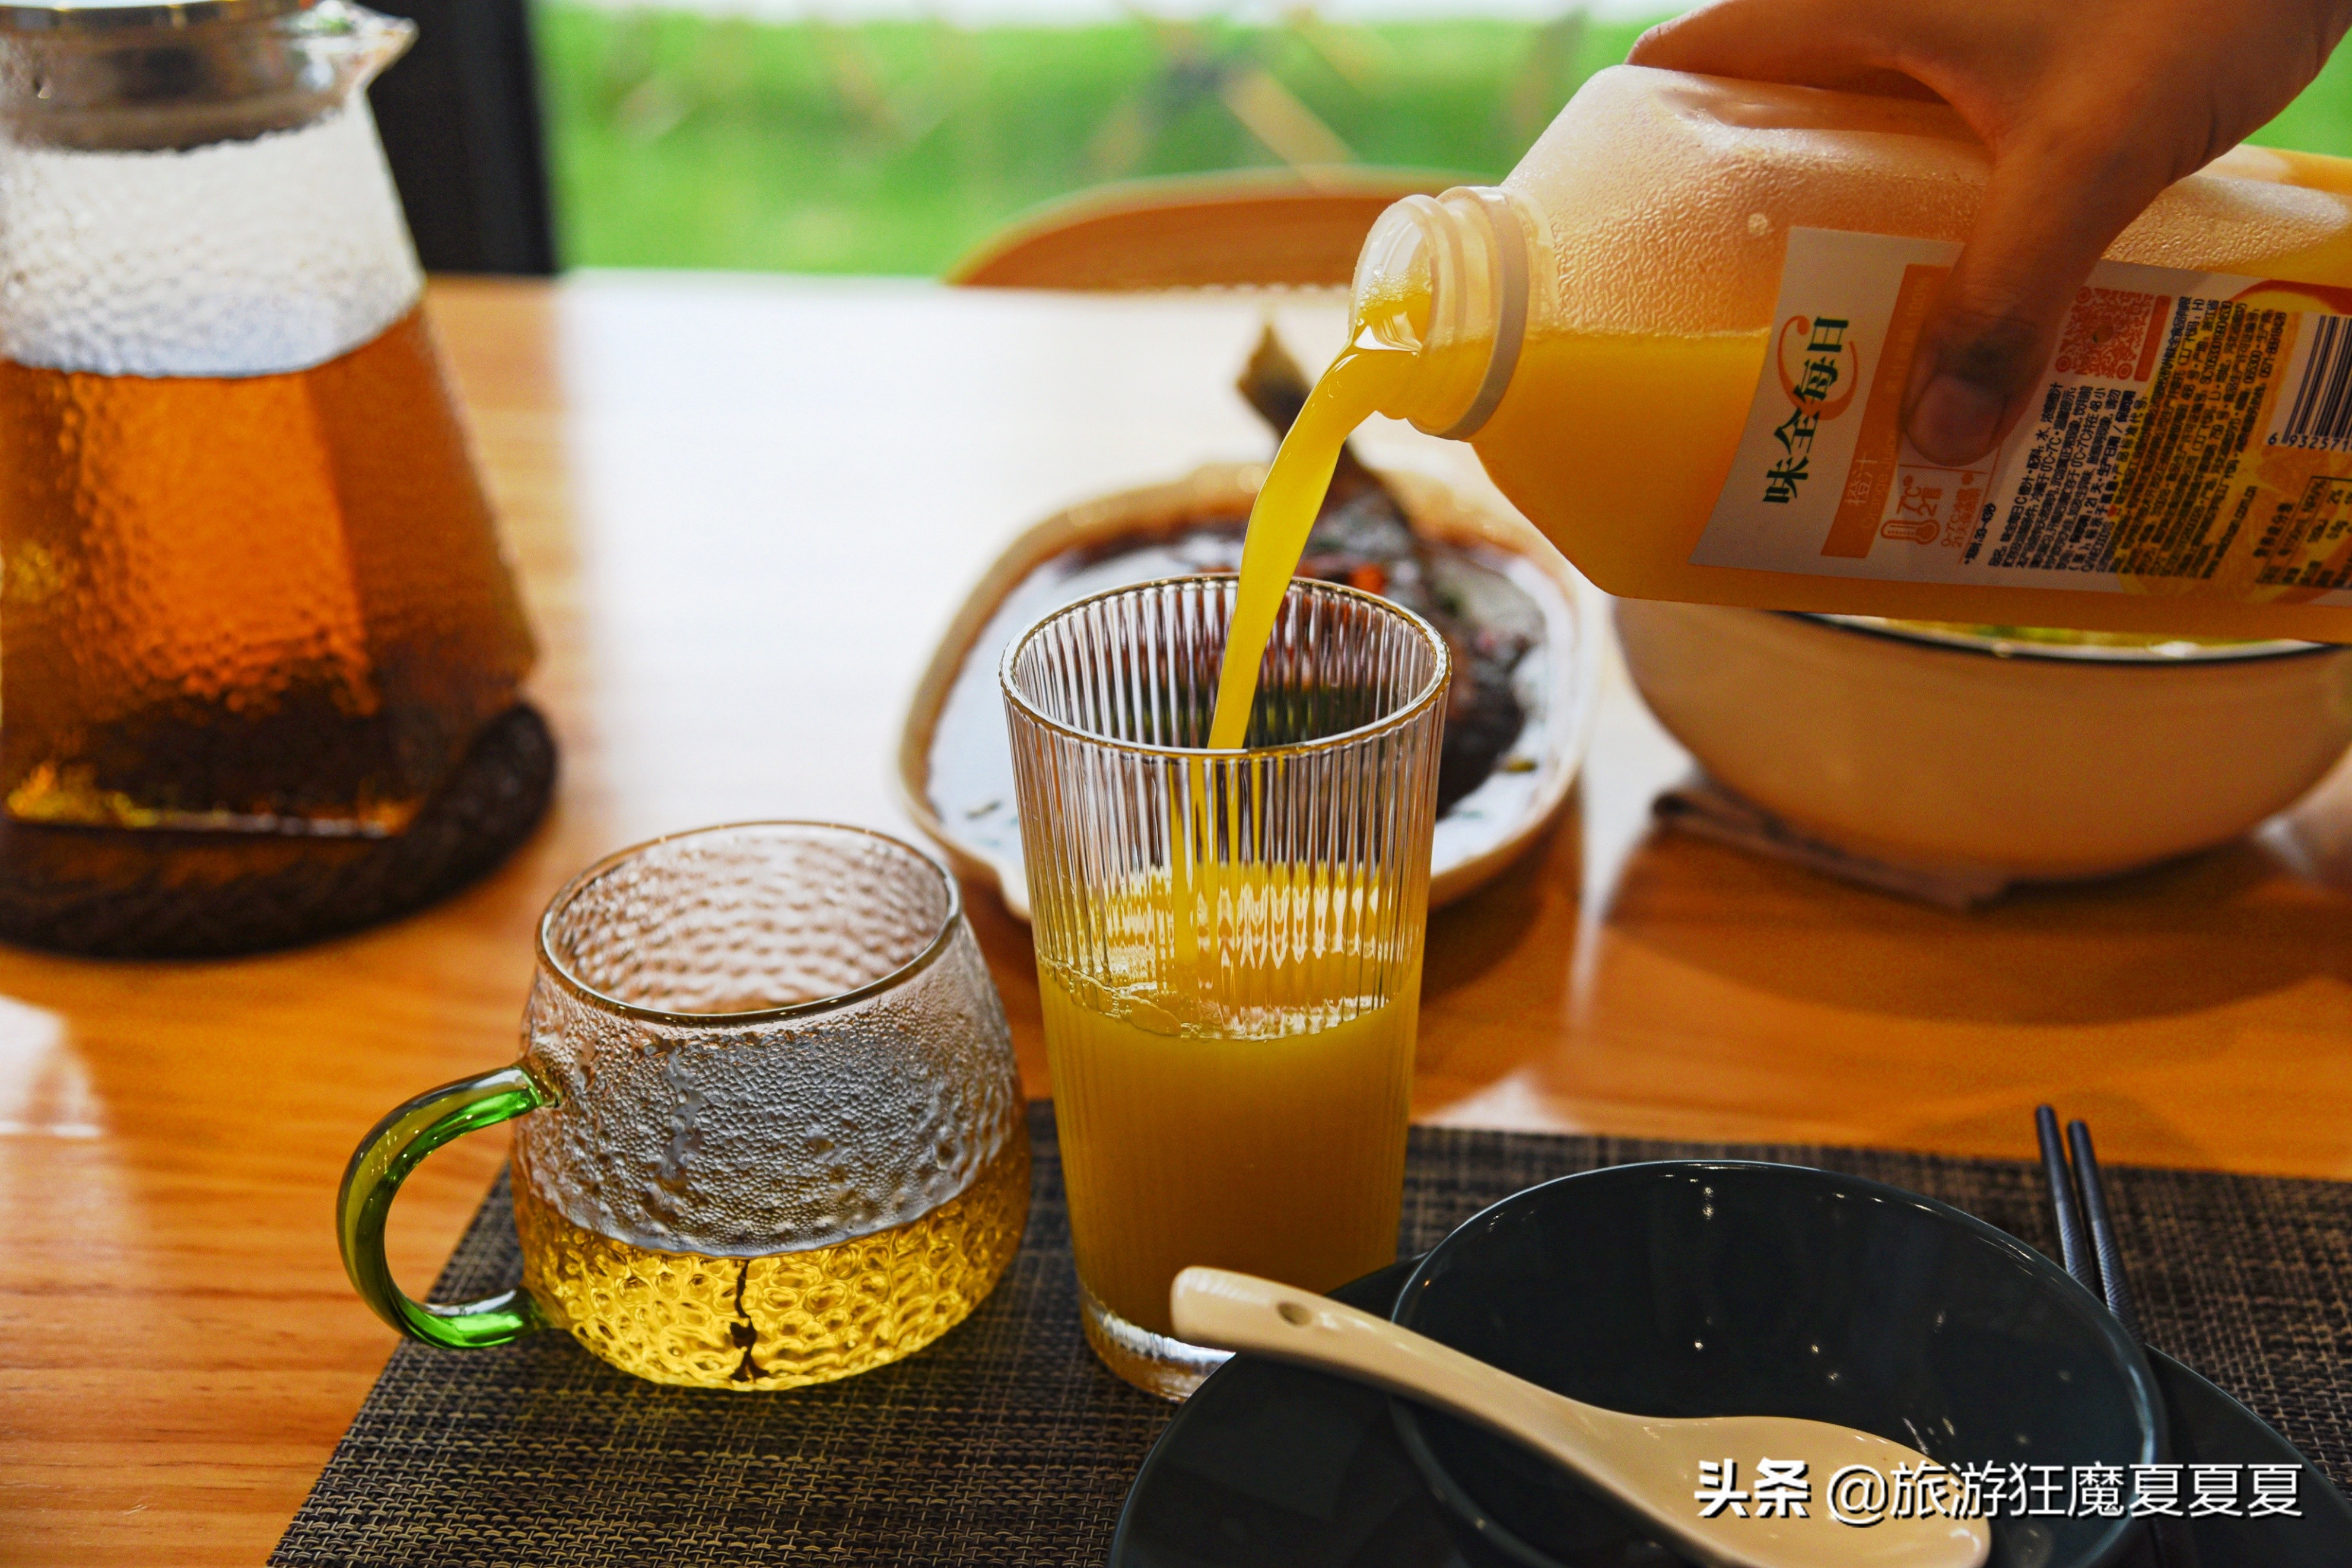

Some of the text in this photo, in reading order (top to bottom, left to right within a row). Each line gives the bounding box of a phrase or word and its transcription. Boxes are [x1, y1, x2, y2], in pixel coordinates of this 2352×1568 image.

[1762, 316, 1849, 504] 味全每日
[2268, 432, 2278, 446] 6
[1844, 451, 1878, 505] 橙汁
[1862, 428, 1898, 530] Orange Juice
